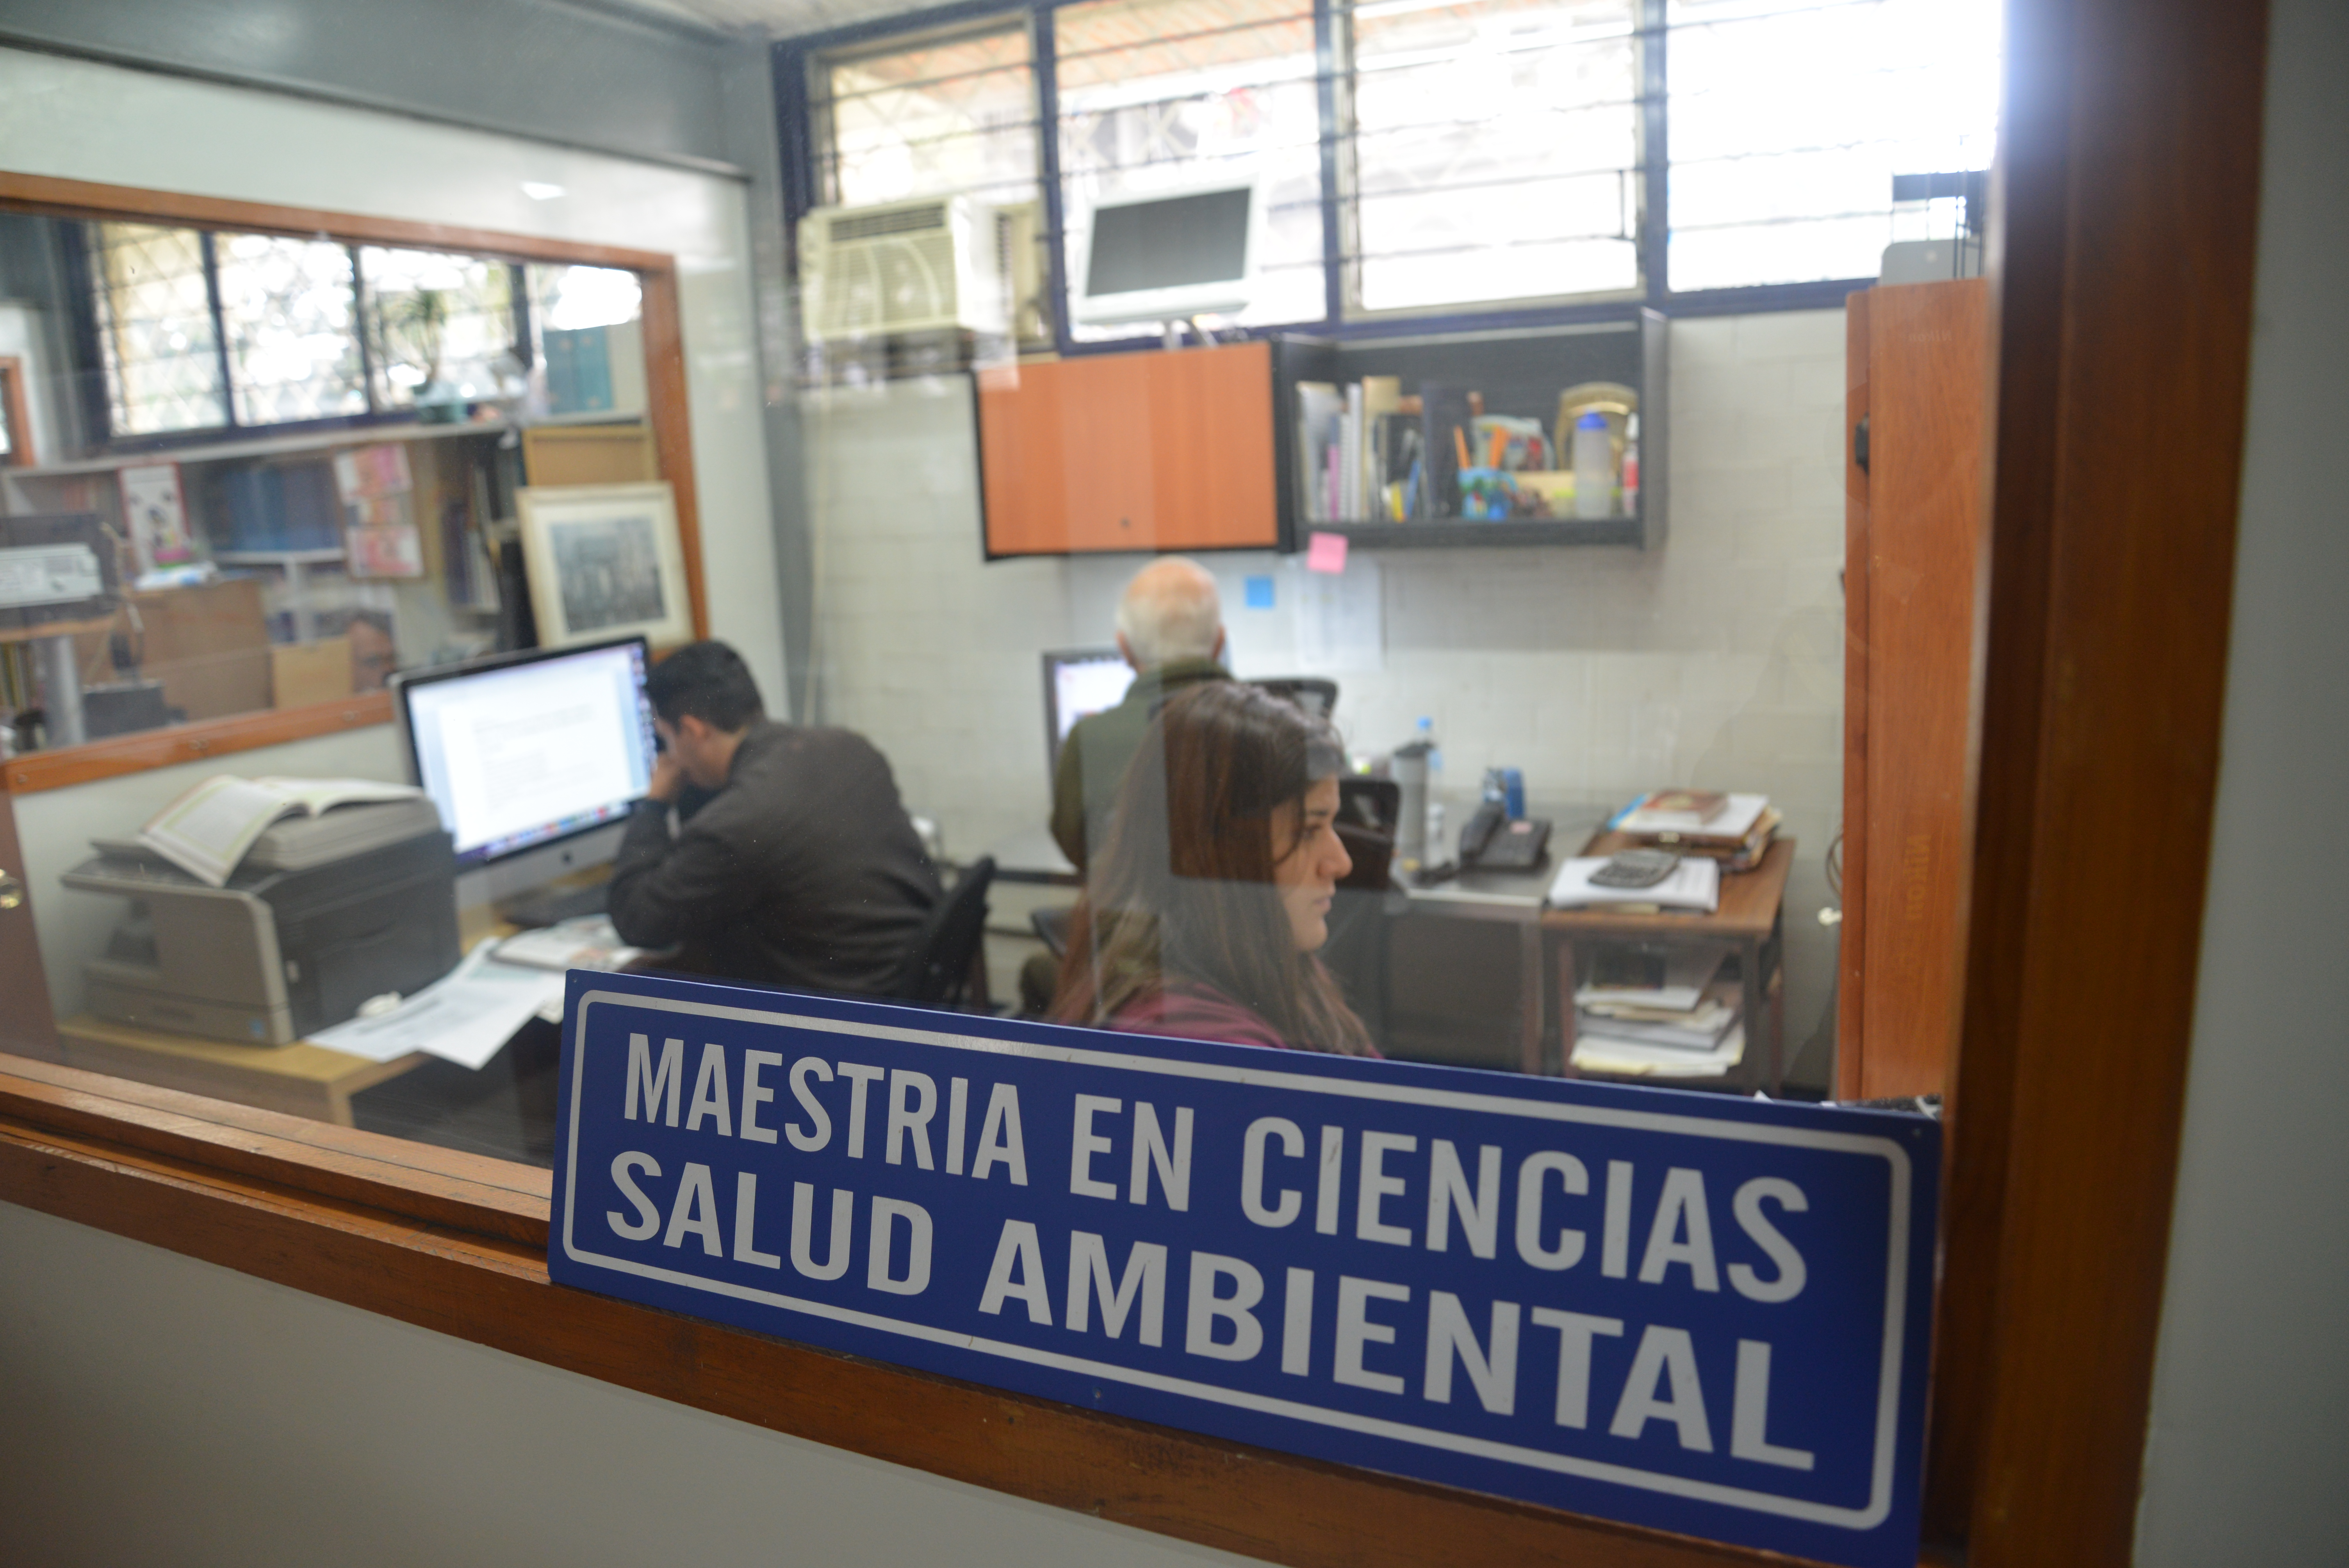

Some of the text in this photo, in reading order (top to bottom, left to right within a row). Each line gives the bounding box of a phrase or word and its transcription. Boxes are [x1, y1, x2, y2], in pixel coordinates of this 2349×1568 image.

[606, 1151, 1813, 1469] SALUD AMBIENTAL
[624, 1032, 1807, 1303] MAESTRIA EN CIENCIAS
